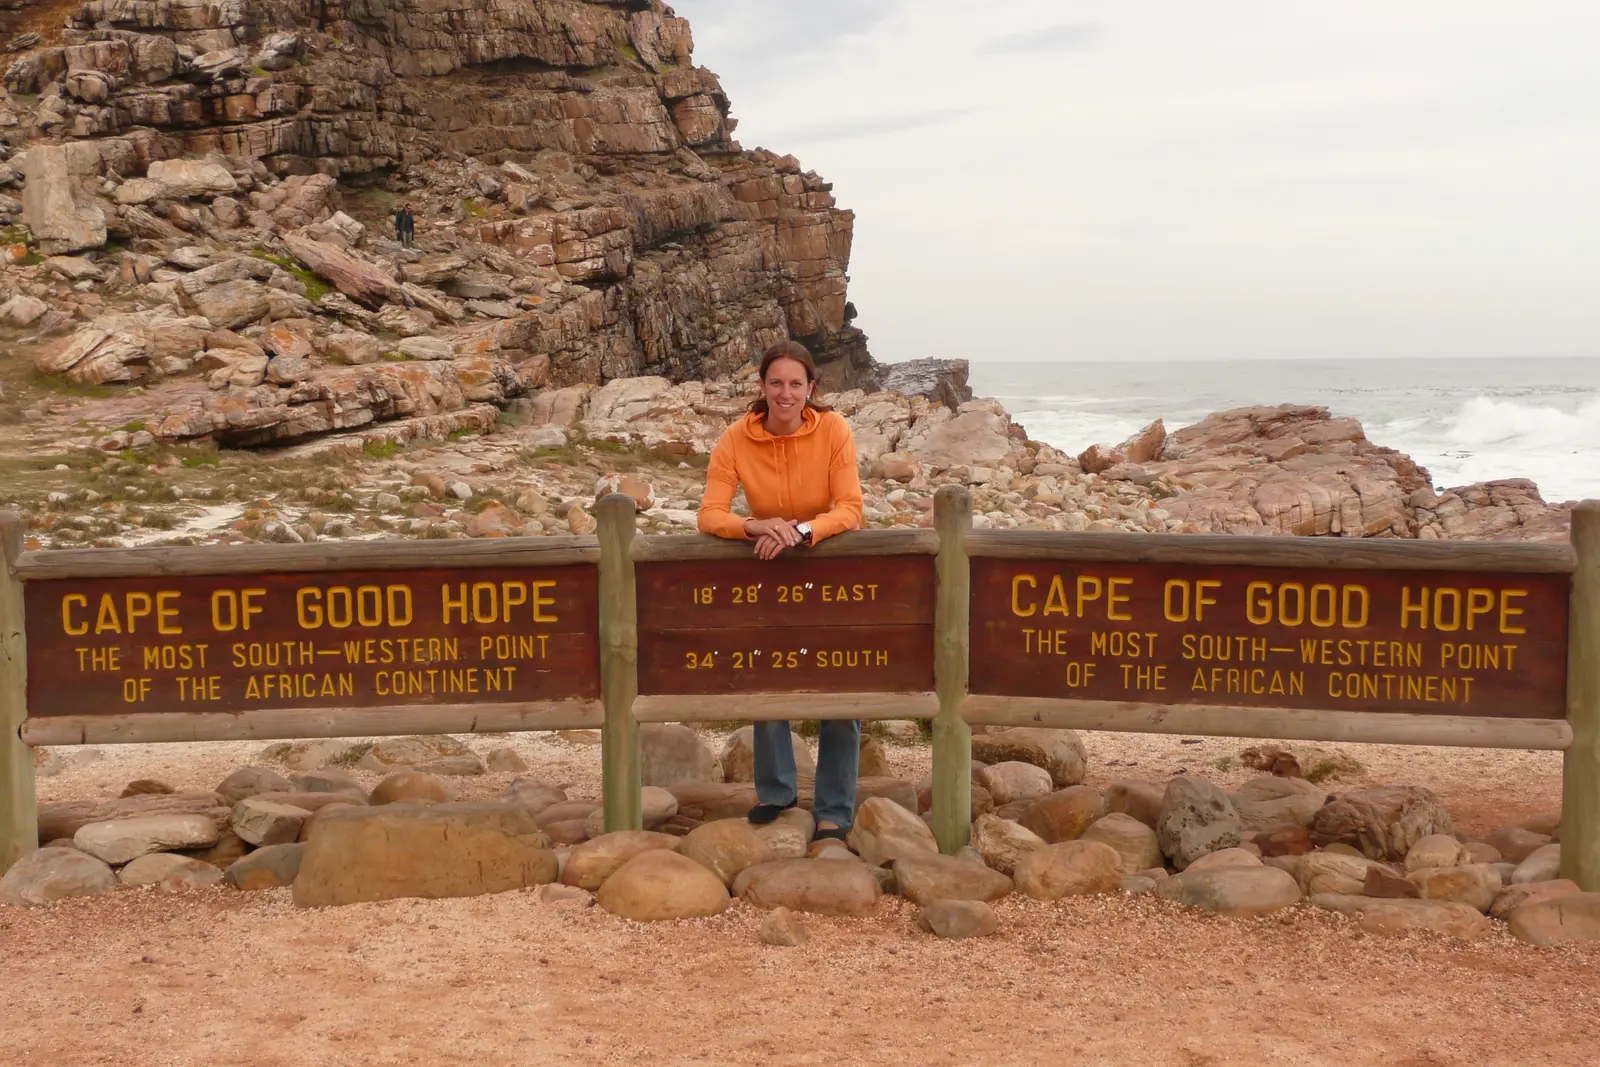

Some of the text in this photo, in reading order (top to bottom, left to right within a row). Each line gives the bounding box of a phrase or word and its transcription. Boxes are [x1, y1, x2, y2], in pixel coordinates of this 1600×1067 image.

[62, 581, 558, 636] CAPE OF GOOD HOPE
[822, 584, 878, 602] EAST
[1011, 575, 1528, 634] CAPE OF GOOD HOPE
[75, 647, 121, 672] THE
[143, 644, 209, 670] MOST
[480, 635, 549, 660] POINT
[816, 650, 888, 668] SOUTH
[1021, 628, 1068, 655] THE
[1091, 631, 1159, 658] MOST
[1441, 643, 1517, 671] POINT
[123, 666, 517, 703] OF THE AFRICAN CONTINENT
[1066, 662, 1475, 703] OF THE AFRICAN CONTINENT
